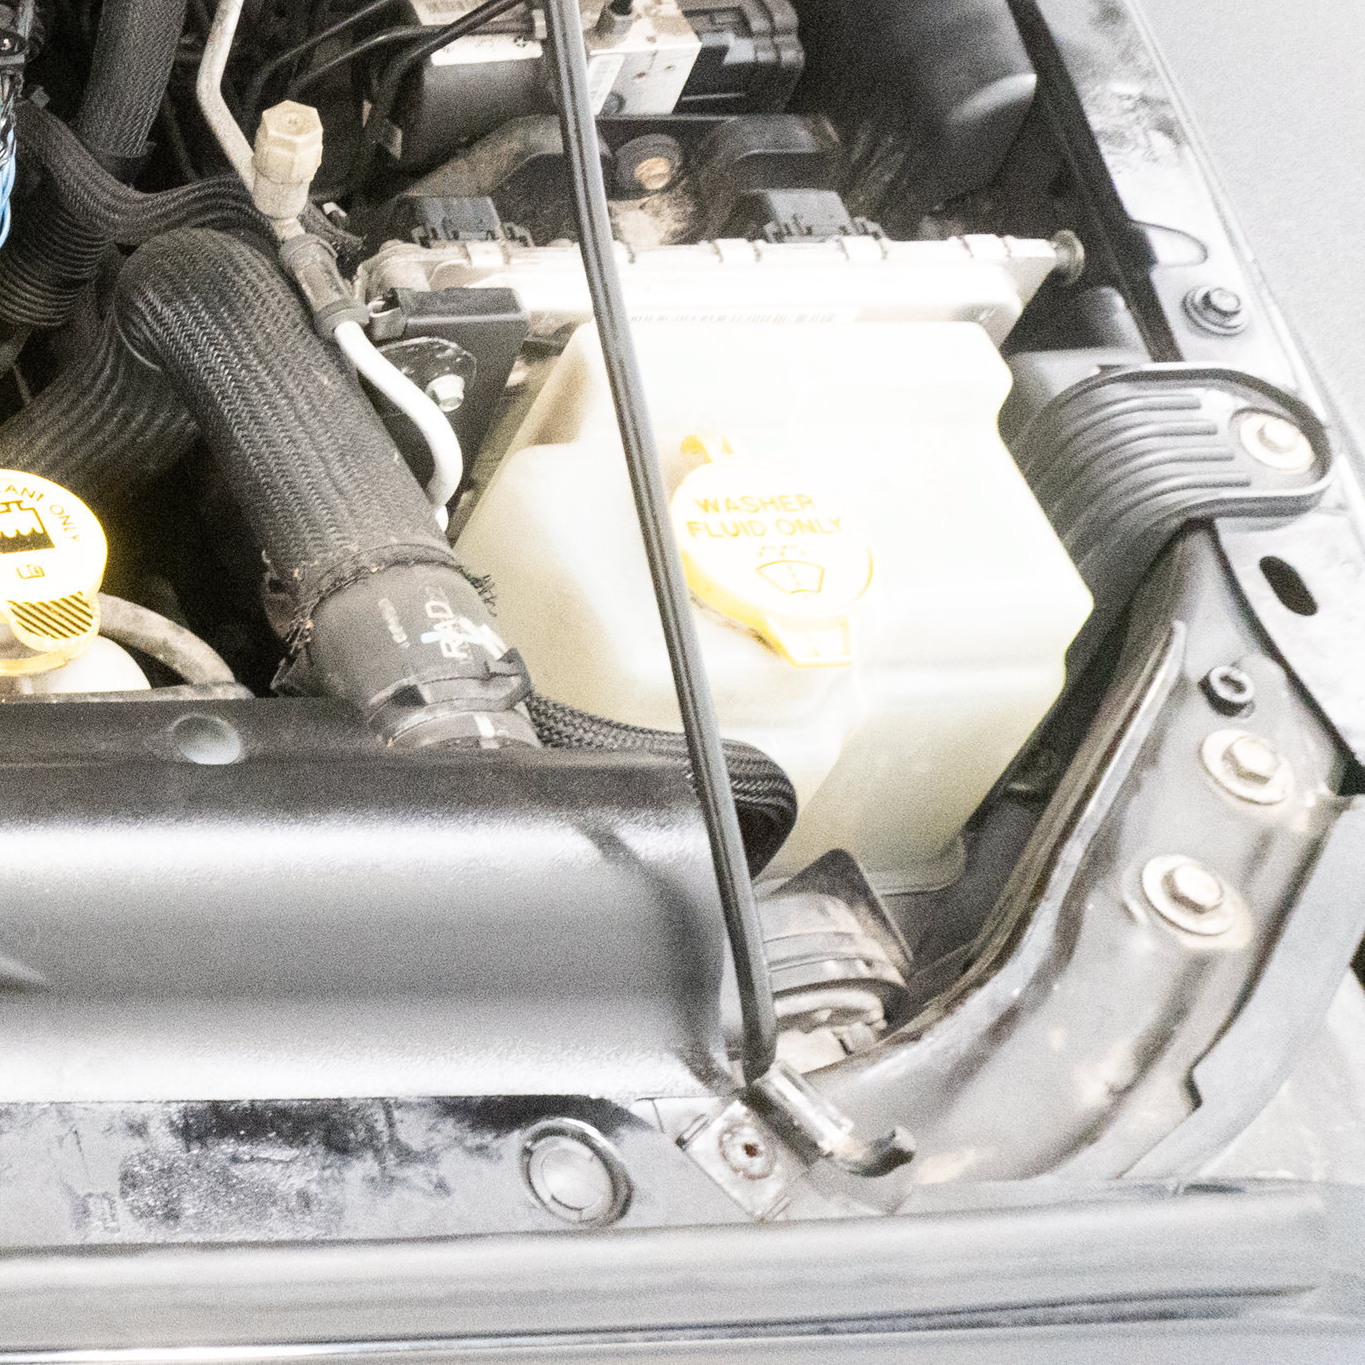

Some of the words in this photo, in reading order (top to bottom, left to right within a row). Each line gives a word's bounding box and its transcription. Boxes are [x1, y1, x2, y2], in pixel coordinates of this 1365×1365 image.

[695, 494, 817, 514] WASHER
[49, 504, 81, 542] ONLY
[685, 520, 767, 538] FLUID
[775, 516, 845, 537] ONLY
